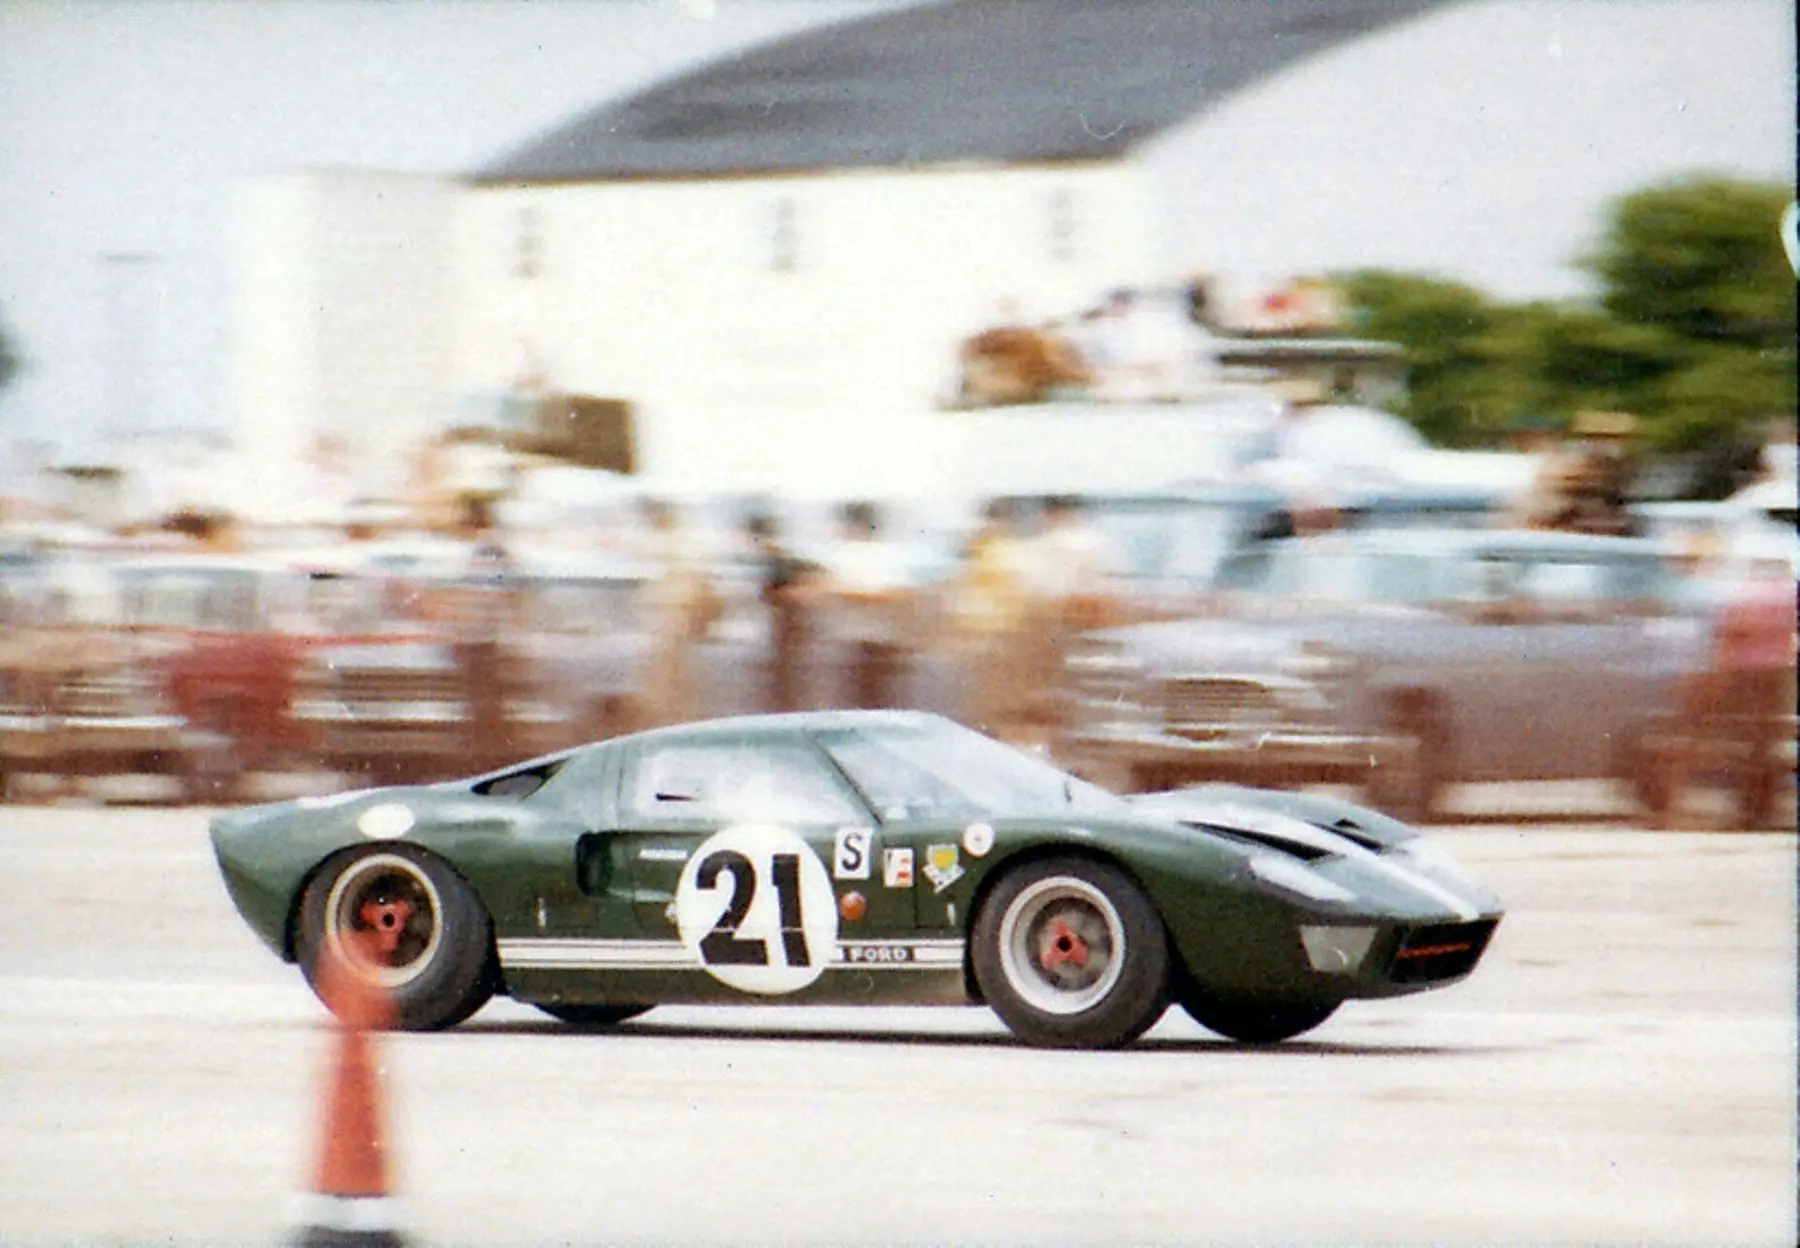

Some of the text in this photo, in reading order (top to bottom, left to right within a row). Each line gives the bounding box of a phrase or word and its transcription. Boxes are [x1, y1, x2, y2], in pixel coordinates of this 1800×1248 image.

[842, 832, 862, 872] S
[696, 849, 811, 967] 21
[850, 946, 908, 961] FORD
